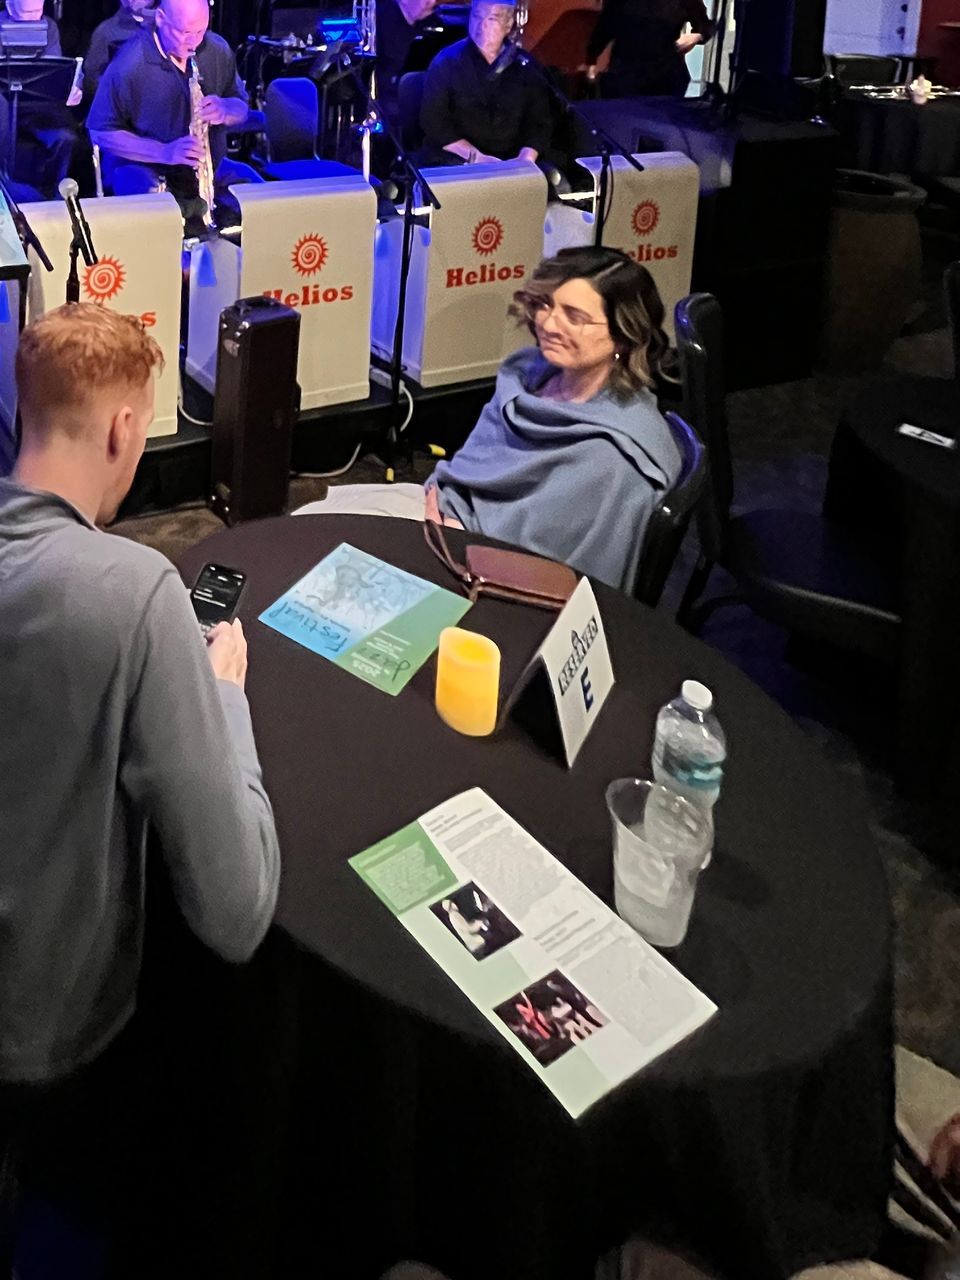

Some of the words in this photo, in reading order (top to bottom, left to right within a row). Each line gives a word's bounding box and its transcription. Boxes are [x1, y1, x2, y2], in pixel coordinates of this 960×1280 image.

[446, 263, 525, 288] Helios
[269, 602, 347, 652] Festival
[580, 666, 594, 713] E
